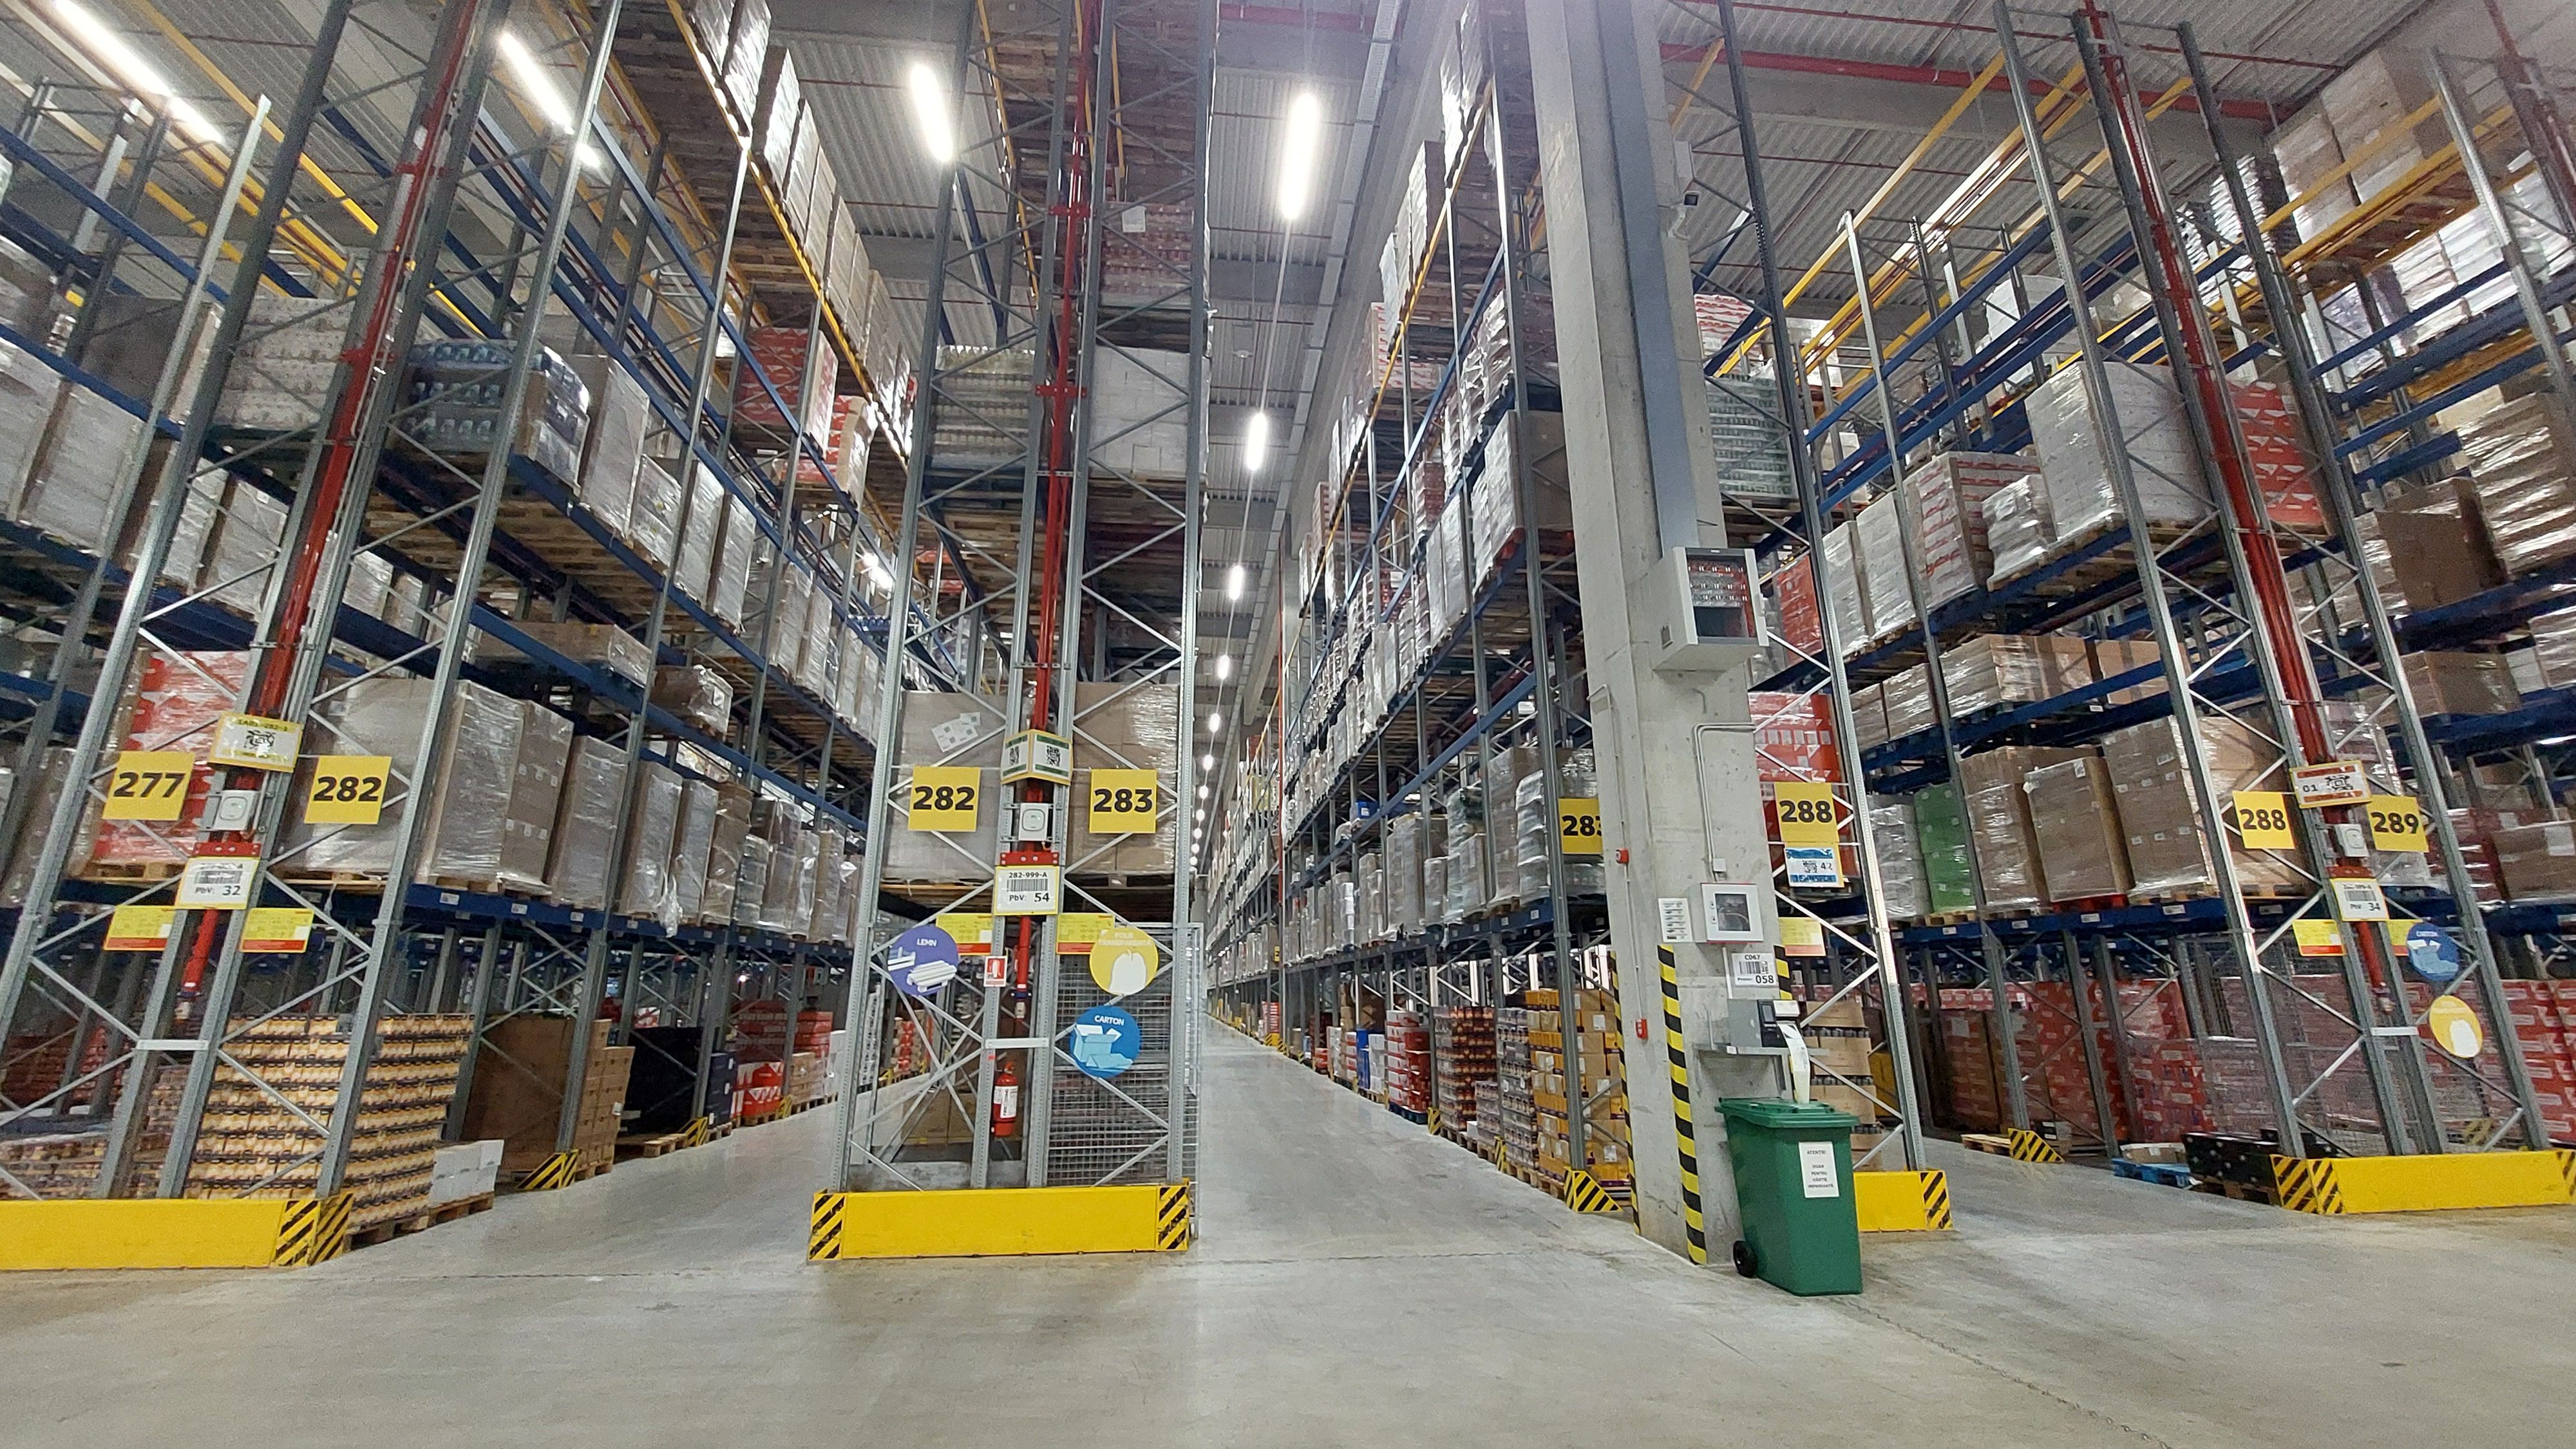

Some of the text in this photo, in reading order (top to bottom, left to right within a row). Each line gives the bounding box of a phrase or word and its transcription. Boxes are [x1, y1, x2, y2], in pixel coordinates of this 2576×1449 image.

[113, 773, 186, 798] 277
[313, 776, 383, 802] 282
[2302, 784, 2318, 793] 01
[913, 786, 976, 811] 282
[1094, 788, 1153, 813] 283
[1779, 800, 1833, 823] 288
[2239, 808, 2286, 831] 288
[2370, 812, 2420, 834] 289
[222, 885, 242, 896] 32
[1034, 893, 1050, 902] 54
[2367, 902, 2381, 911] 34
[916, 938, 938, 947] LEMN
[1755, 975, 1775, 984] 058
[1094, 1015, 1125, 1027] CARTON
